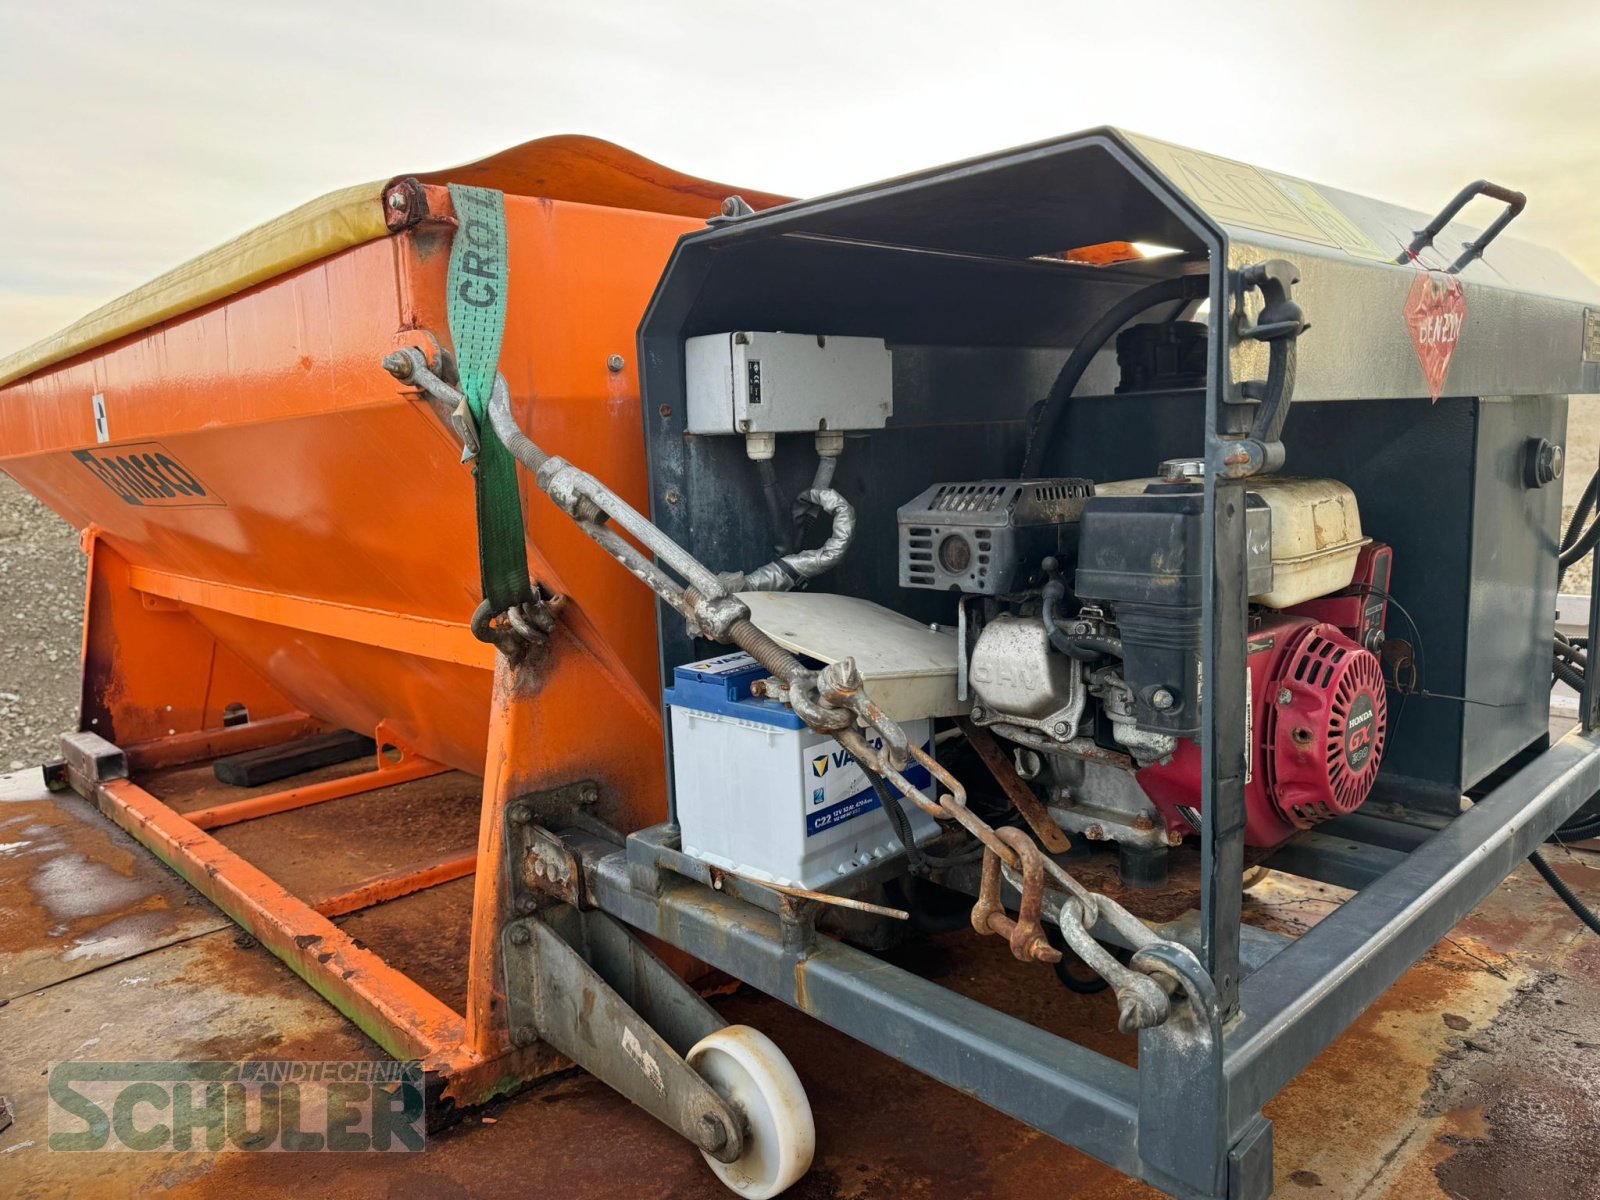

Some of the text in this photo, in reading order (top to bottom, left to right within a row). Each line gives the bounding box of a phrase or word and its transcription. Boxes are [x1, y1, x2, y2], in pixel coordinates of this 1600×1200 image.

[1349, 709, 1373, 729] HONDA
[1348, 722, 1371, 752] GX
[814, 814, 832, 829] C22
